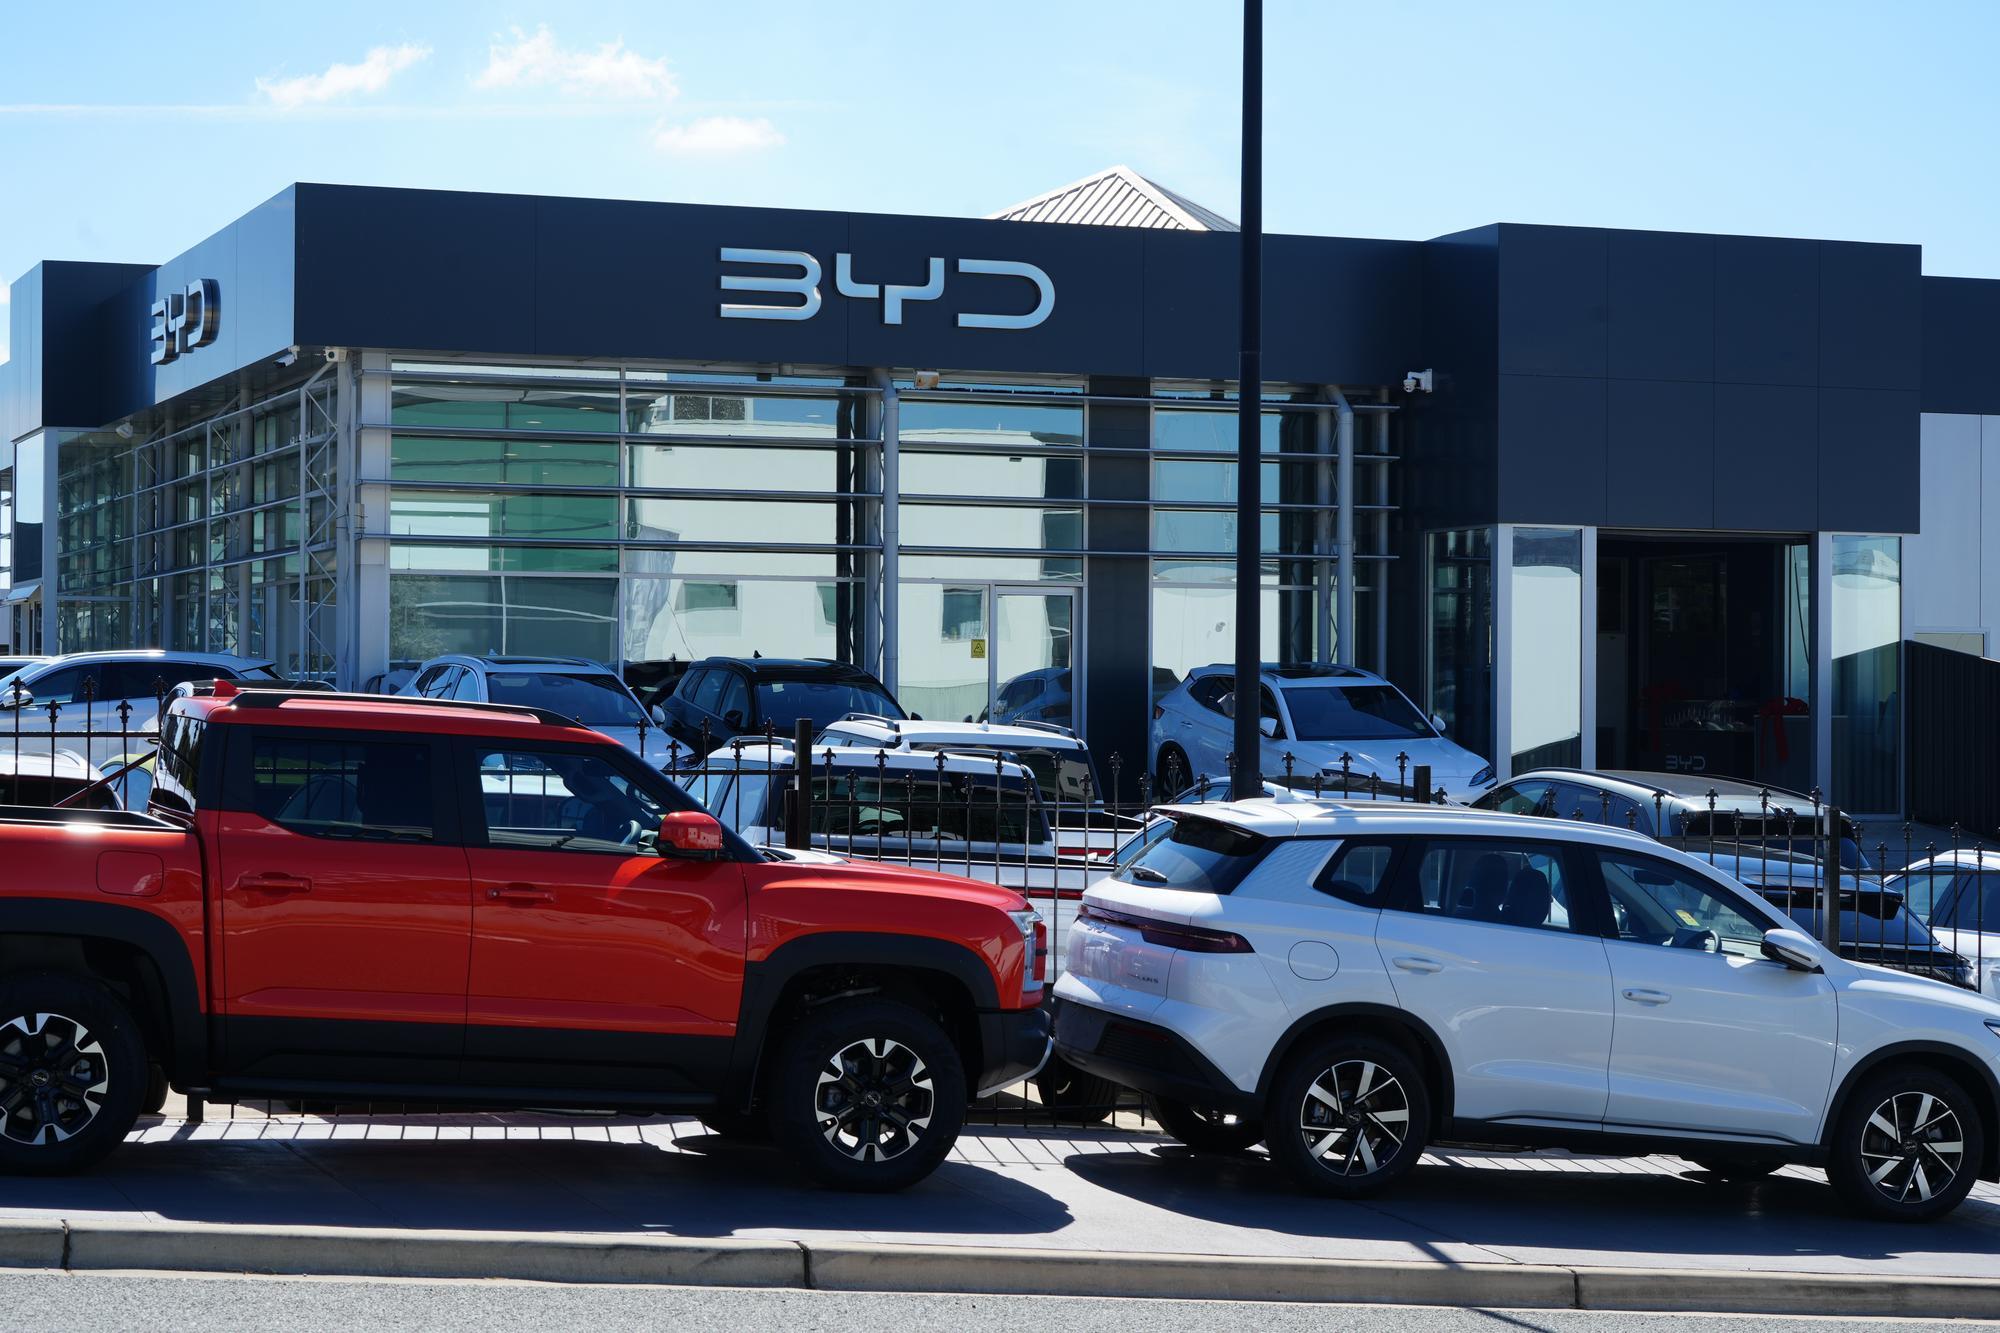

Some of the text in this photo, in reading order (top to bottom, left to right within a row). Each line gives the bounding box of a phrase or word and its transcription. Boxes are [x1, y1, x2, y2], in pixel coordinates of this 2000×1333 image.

[150, 278, 221, 365] BYD
[720, 247, 1056, 329] BYD
[1665, 755, 1706, 770] BYD
